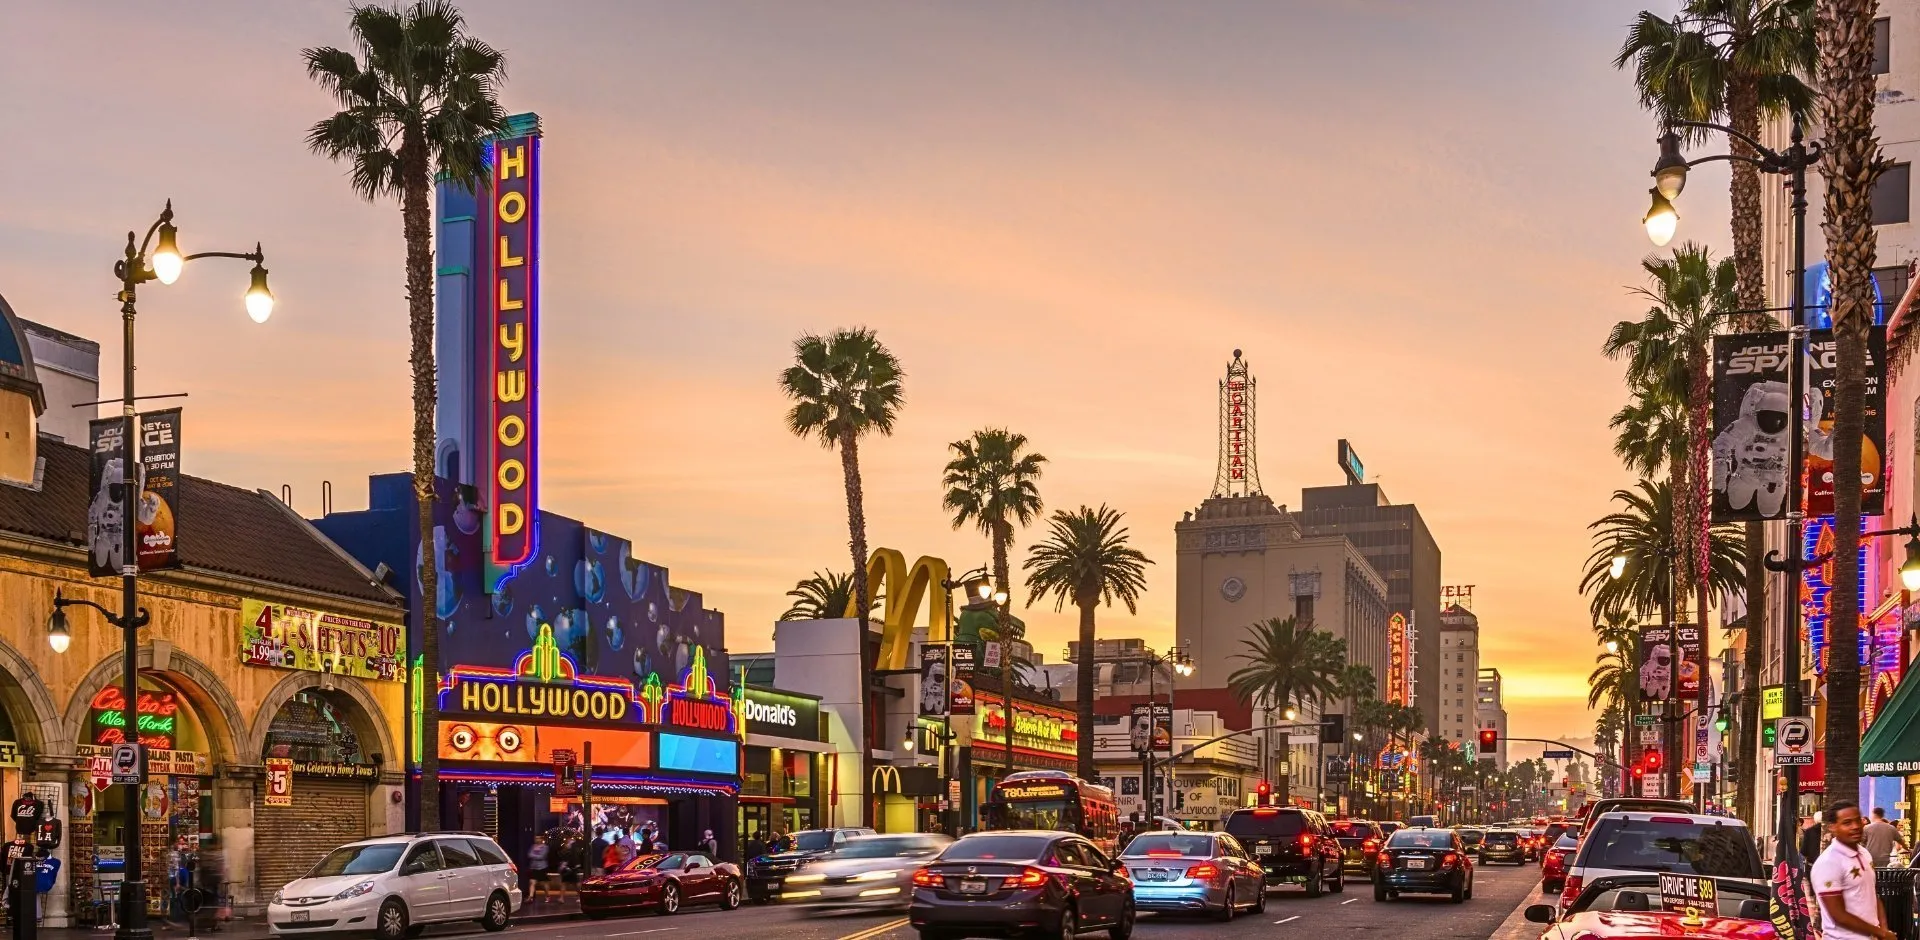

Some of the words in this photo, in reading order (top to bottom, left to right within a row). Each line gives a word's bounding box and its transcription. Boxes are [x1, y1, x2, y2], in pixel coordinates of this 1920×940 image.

[498, 146, 526, 535] HOLLYWOOD
[99, 421, 161, 438] JOUNEY
[95, 428, 174, 454] SPCE
[145, 453, 176, 463] EXHIBITION
[160, 461, 175, 469] FILM
[255, 605, 272, 638] 4
[1392, 632, 1402, 700] CAPITA
[462, 681, 627, 721] HOLLYWOOD
[98, 710, 126, 726] Ne
[672, 701, 727, 732] HOLLYWOOD
[745, 698, 797, 727] Donald's
[76, 745, 95, 756] PIZZA
[148, 751, 171, 762] SALADS
[175, 752, 194, 763] PASTA
[93, 757, 112, 770] ATM
[1778, 756, 1791, 764] PAY
[1793, 756, 1811, 764] HERE
[174, 763, 195, 774] KABOBS
[306, 762, 336, 774] Celebrity
[337, 764, 355, 775] Home
[1863, 762, 1894, 773] CAMERAS
[268, 769, 287, 794] $5
[1174, 779, 1217, 789] OUVENIRS
[1002, 787, 1025, 798] 780
[1189, 792, 1203, 801] OF
[17, 804, 36, 814] Cali
[1661, 875, 1685, 896] DRIVE
[1685, 877, 1698, 897] ME
[1698, 878, 1713, 900] $89
